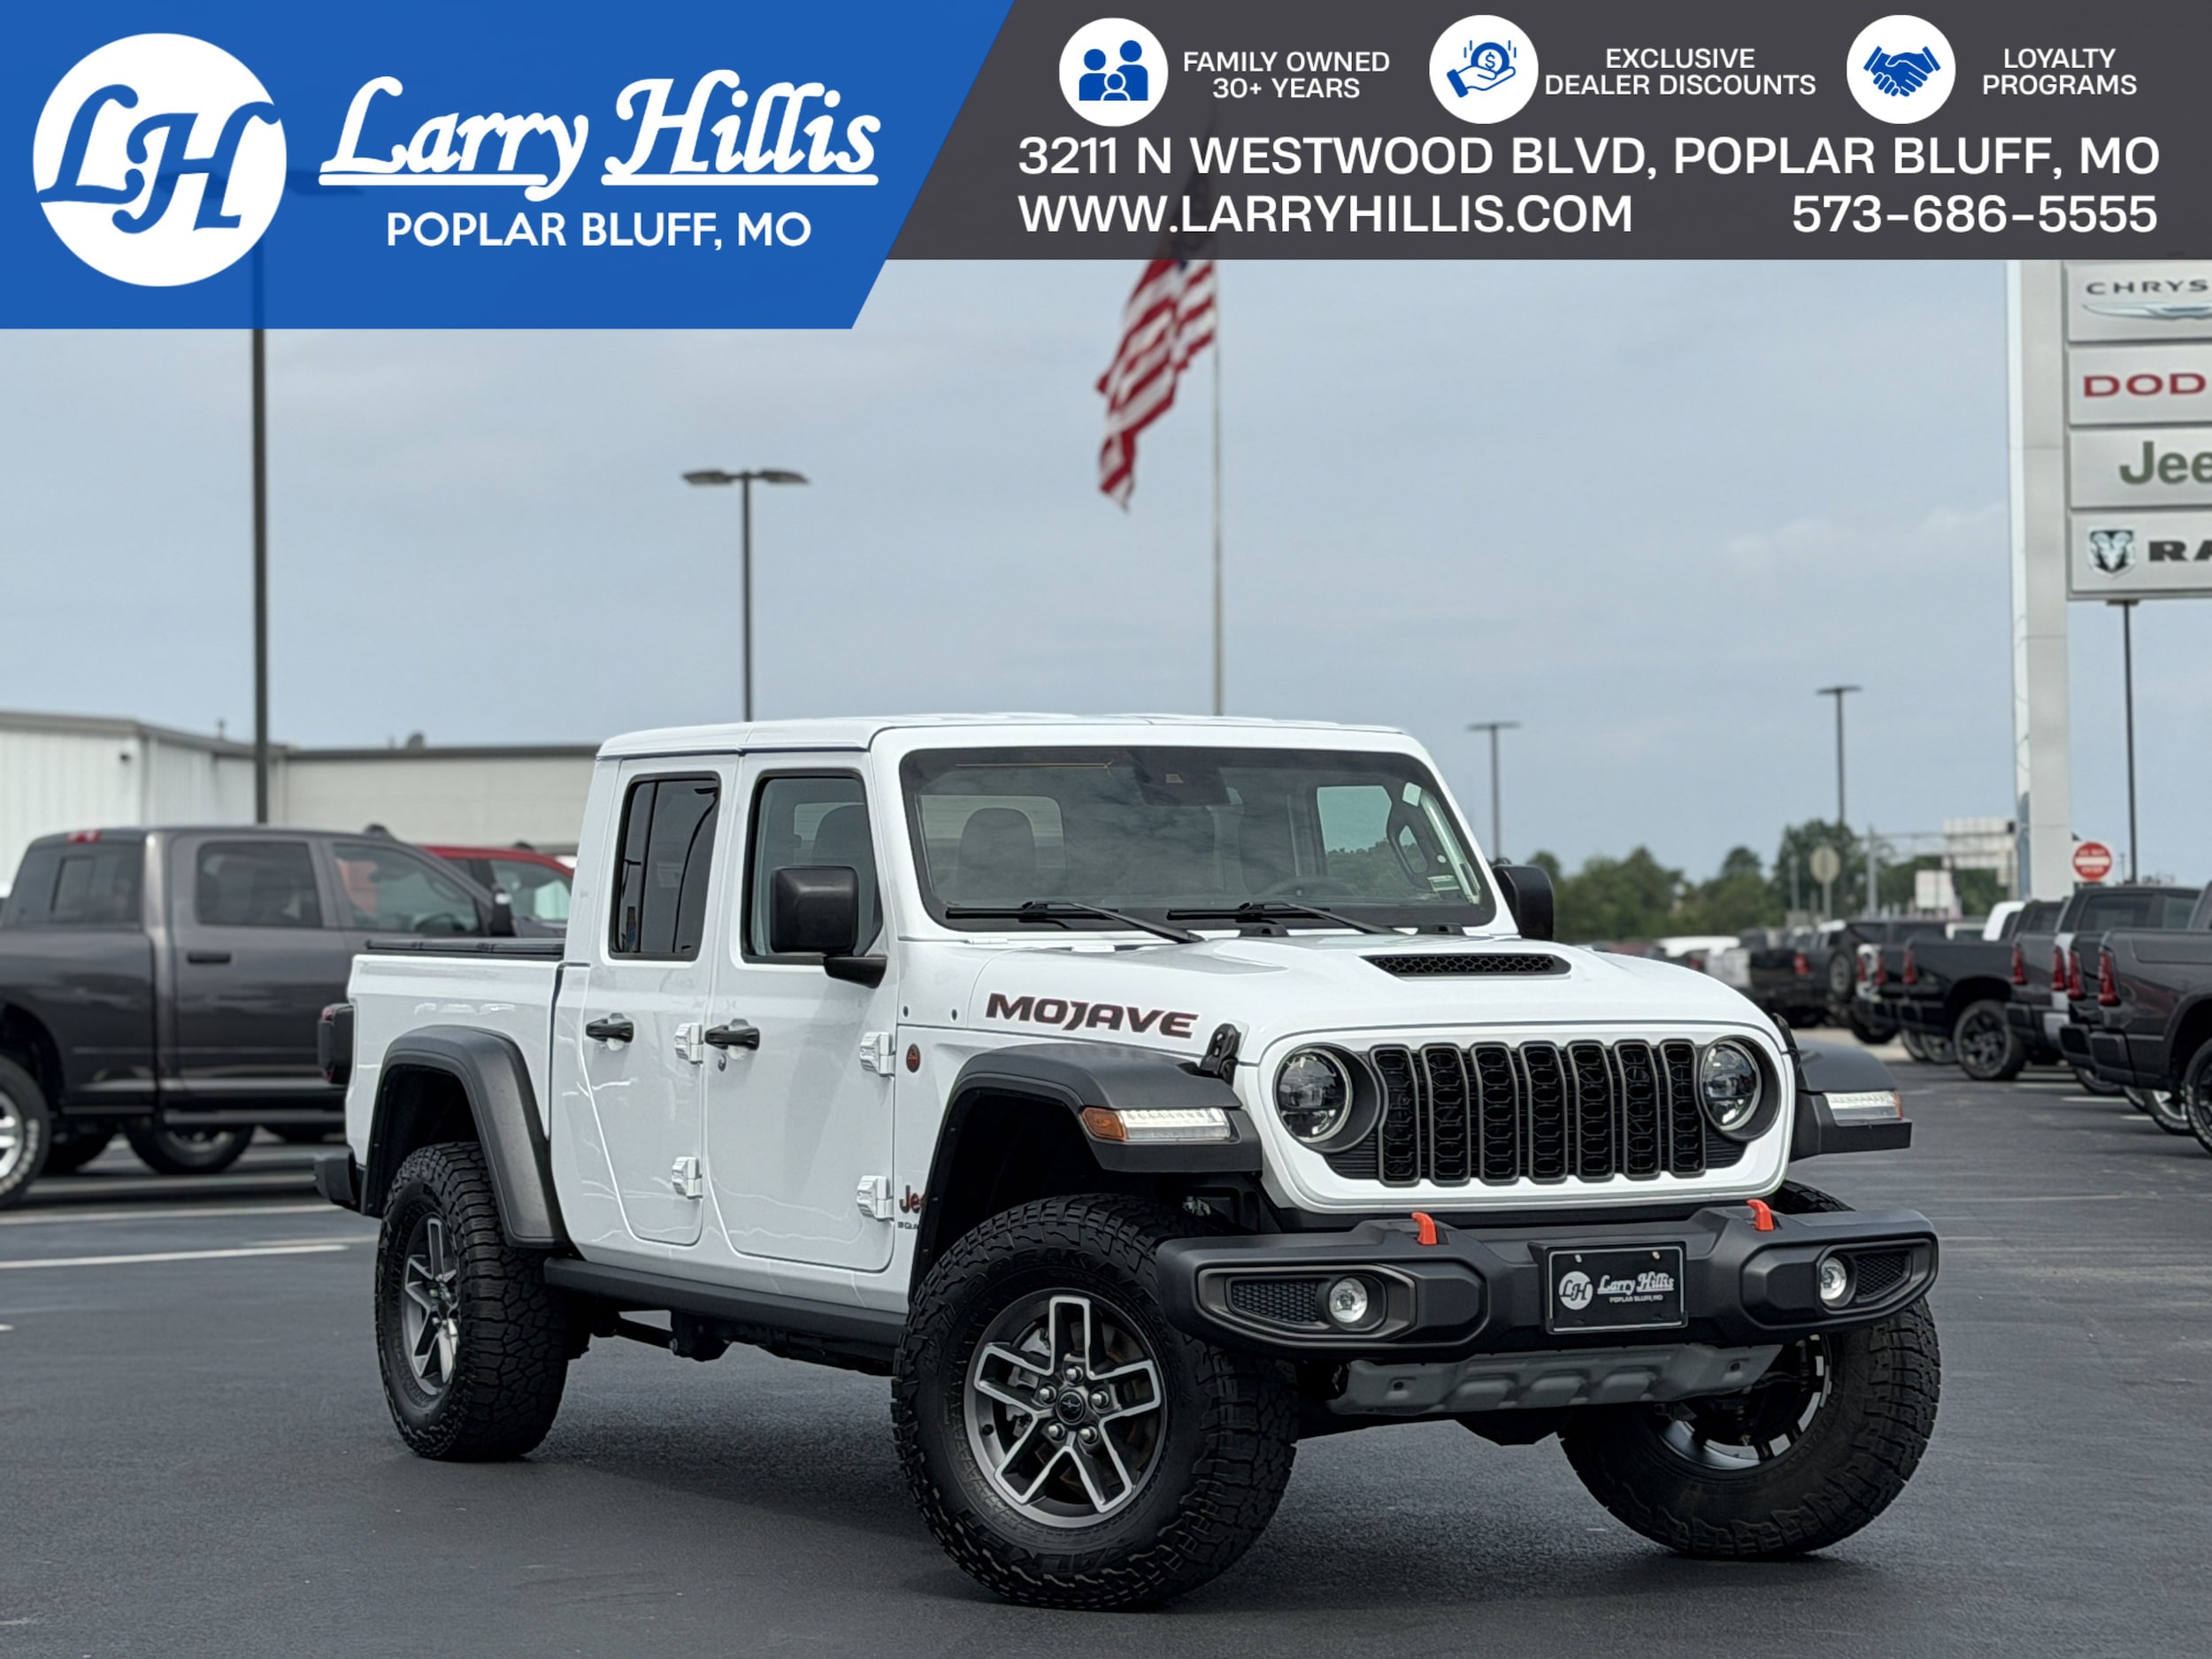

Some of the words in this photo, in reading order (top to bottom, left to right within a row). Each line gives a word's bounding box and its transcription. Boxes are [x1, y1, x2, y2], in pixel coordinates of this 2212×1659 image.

[2085, 279, 2209, 296] CHRYS
[2083, 373, 2208, 398] DOD
[986, 993, 1199, 1039] MOJAVE
[1597, 1275, 1636, 1295] Larry
[1636, 1271, 1675, 1292] Hillis
